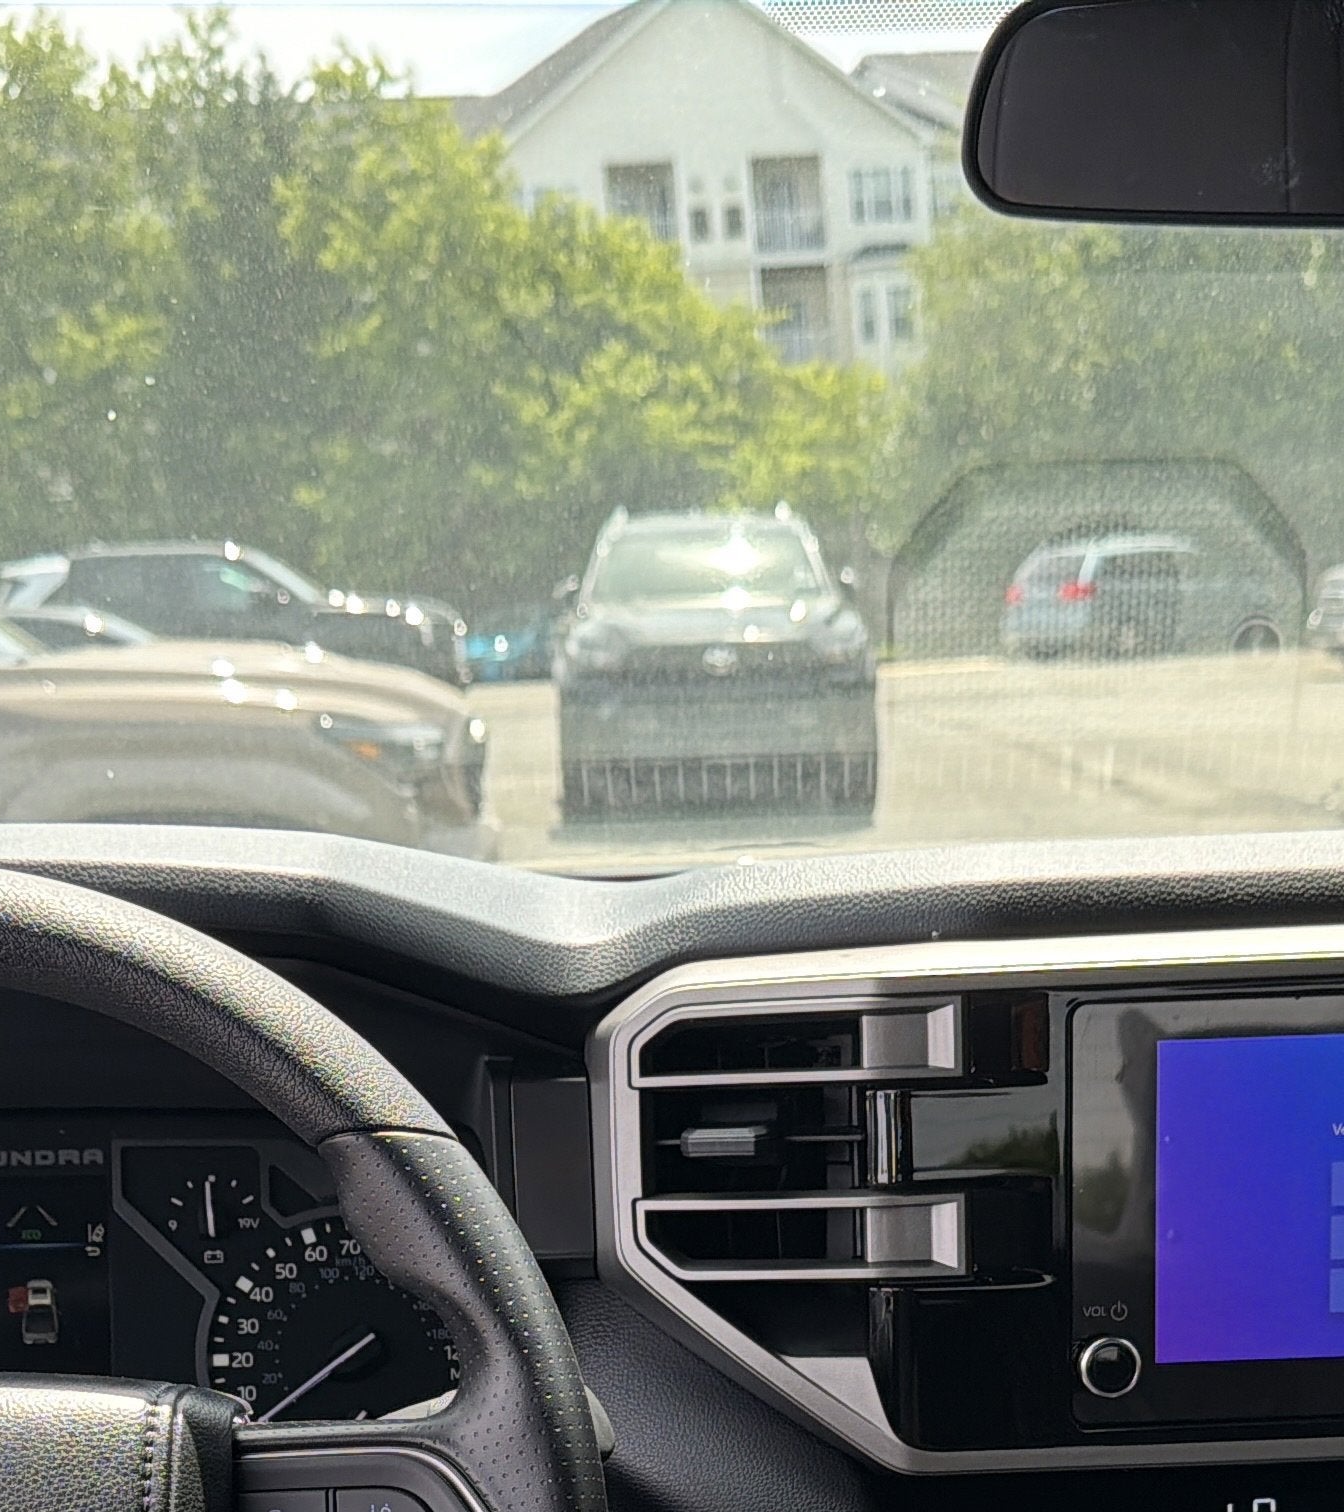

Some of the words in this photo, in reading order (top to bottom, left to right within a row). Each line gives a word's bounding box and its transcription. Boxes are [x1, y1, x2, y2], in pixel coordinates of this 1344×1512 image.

[167, 1219, 178, 1232] 9
[237, 1218, 260, 1229] 19V
[304, 1245, 328, 1262] 60
[338, 1240, 361, 1256] 70
[275, 1263, 297, 1280] 50
[319, 1267, 340, 1280] 100
[250, 1286, 274, 1303] 40
[288, 1282, 305, 1293] 80
[267, 1309, 283, 1320] 60
[1082, 1306, 1107, 1317] VOL
[236, 1318, 259, 1335] 30
[257, 1341, 274, 1351] 40
[231, 1351, 254, 1368] 20
[261, 1374, 277, 1384] 20
[237, 1385, 257, 1401] 10
